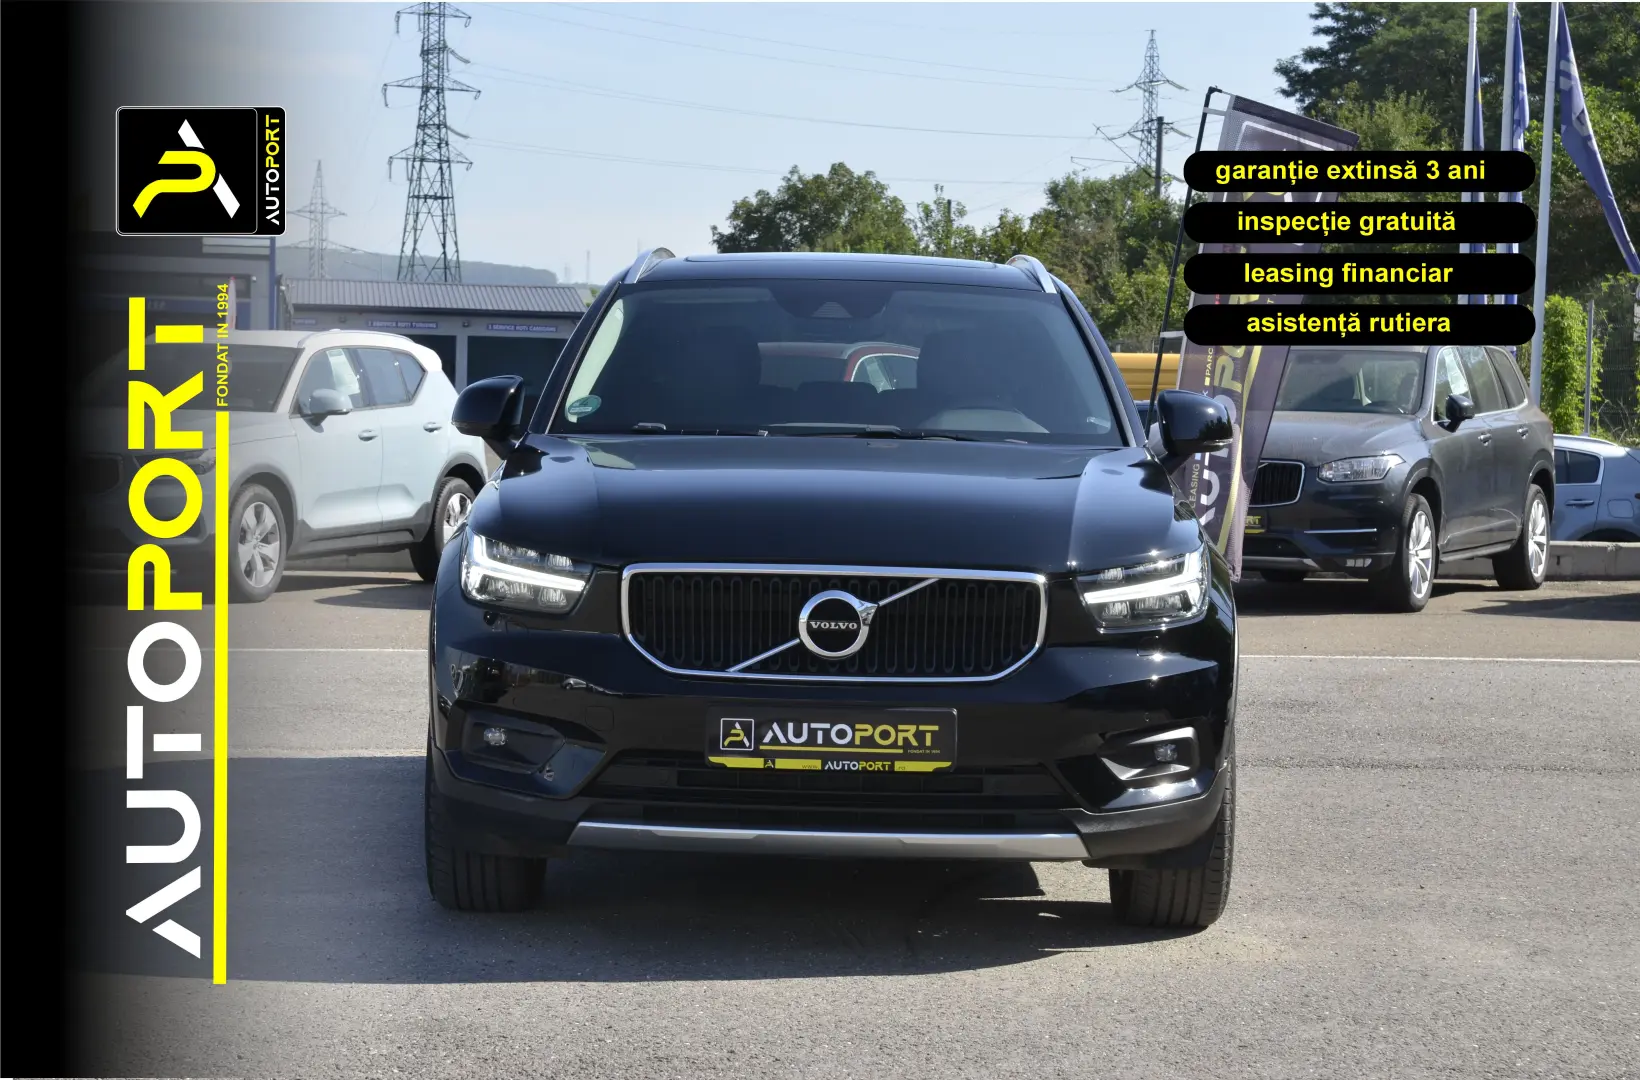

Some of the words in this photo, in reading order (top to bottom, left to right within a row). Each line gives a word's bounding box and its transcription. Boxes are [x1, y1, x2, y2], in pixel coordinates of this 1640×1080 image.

[1189, 463, 1200, 508] LEASING
[810, 621, 858, 630] VOLVO
[762, 722, 939, 747] AUTOPORT
[824, 761, 892, 771] AUTOPORT
